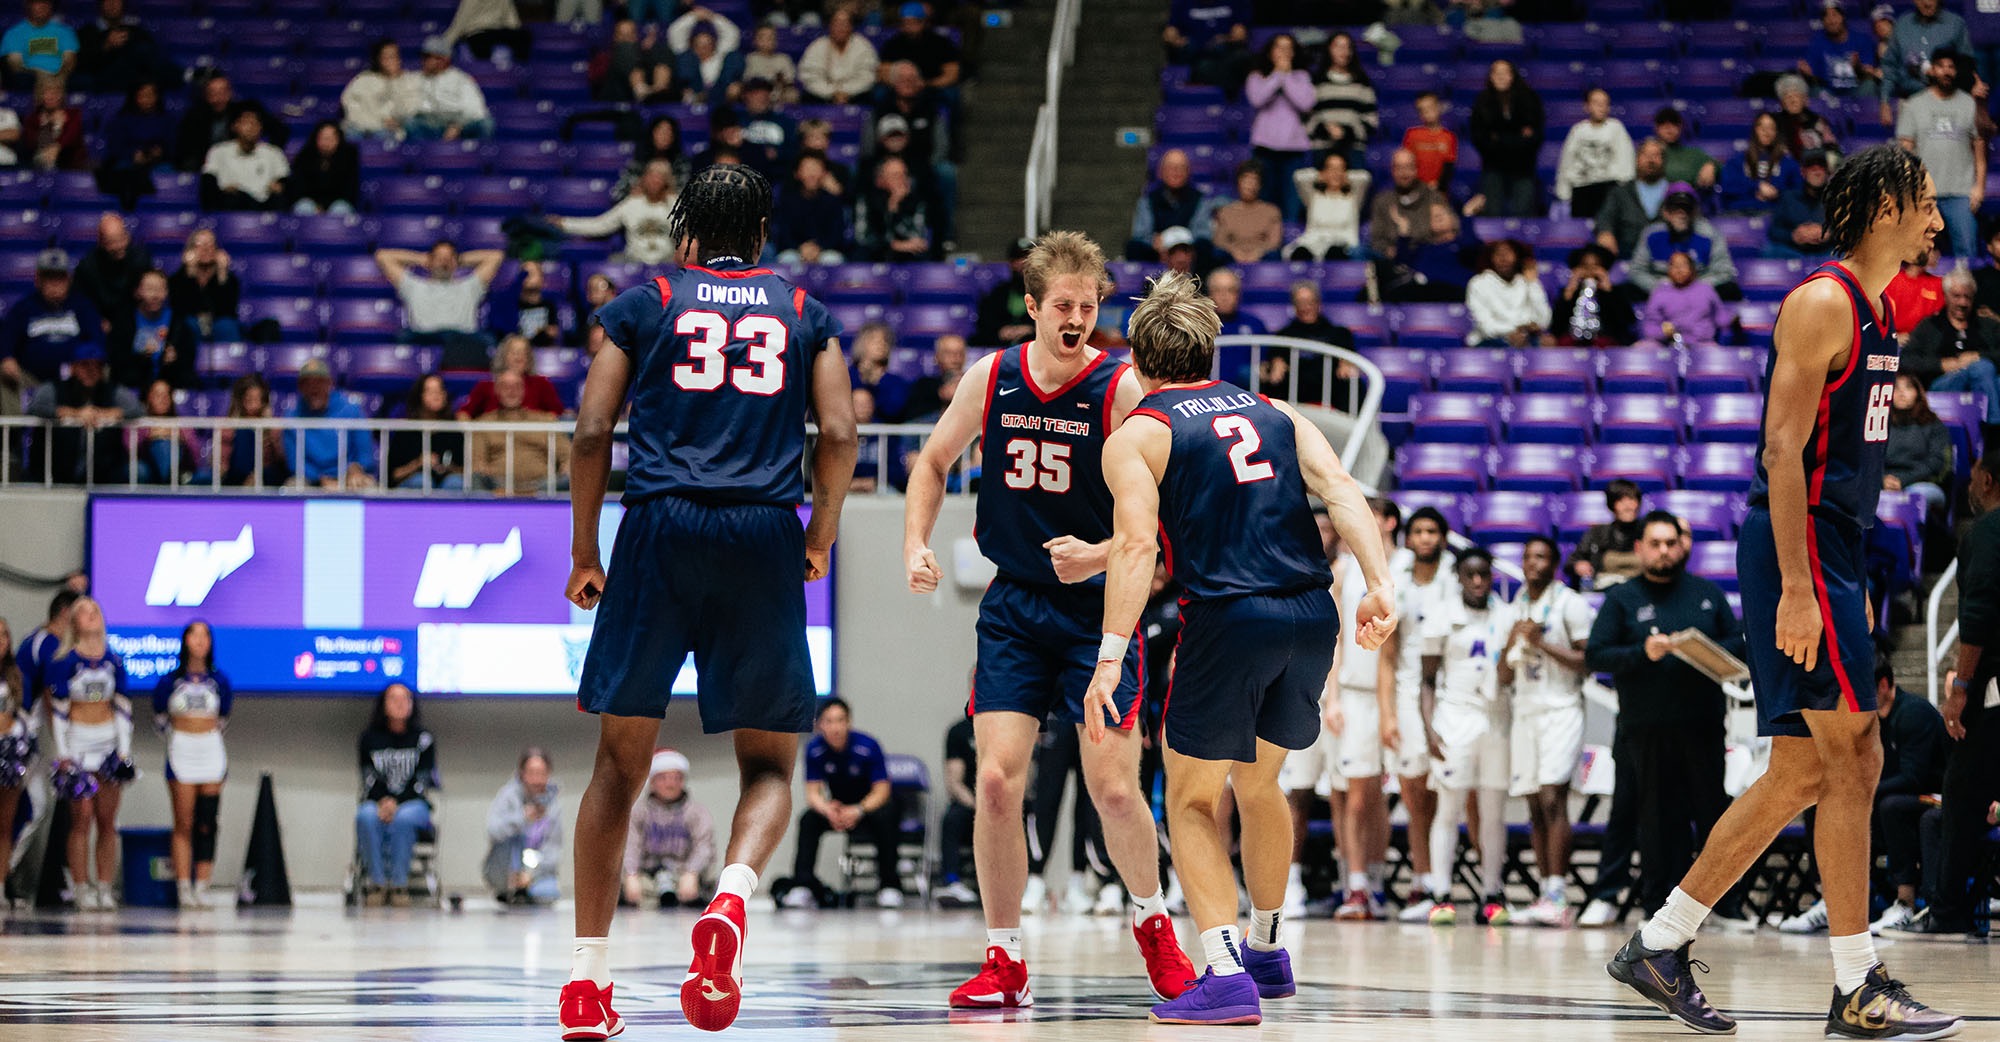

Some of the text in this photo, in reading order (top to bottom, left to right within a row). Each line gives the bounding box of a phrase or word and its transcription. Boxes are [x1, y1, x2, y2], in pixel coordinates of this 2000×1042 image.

[697, 283, 768, 305] OWONA
[672, 309, 789, 396] 33
[1001, 413, 1090, 436] UTAH TECH
[1172, 393, 1257, 419] TRUJILLO
[1863, 382, 1894, 442] 66
[1004, 437, 1072, 495] 35
[1210, 413, 1276, 485] 2
